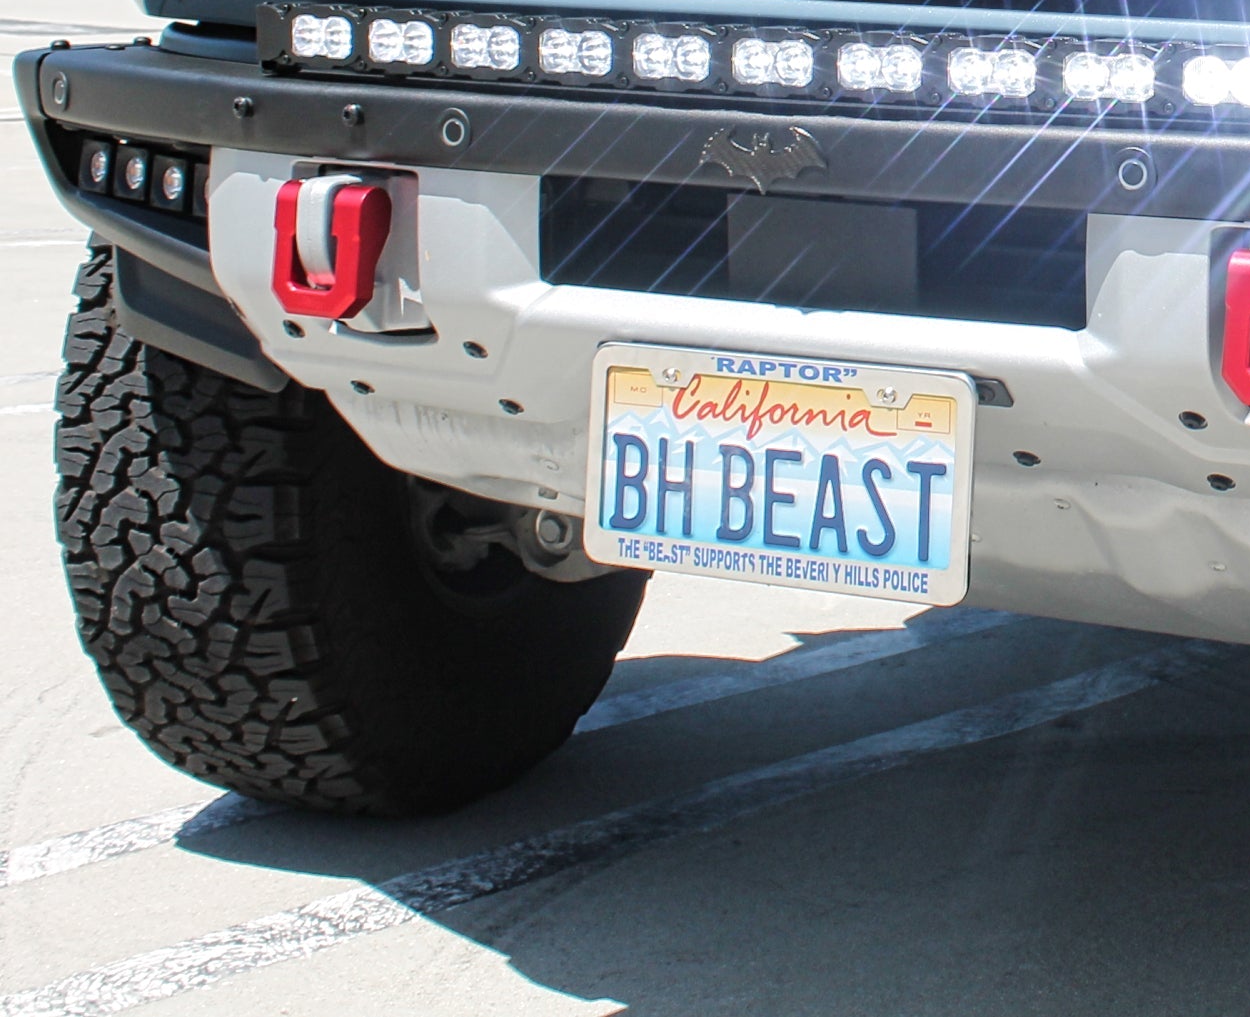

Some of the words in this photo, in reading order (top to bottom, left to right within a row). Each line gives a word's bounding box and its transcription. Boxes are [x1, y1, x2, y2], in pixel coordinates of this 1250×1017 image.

[671, 374, 898, 441] California
[609, 433, 695, 536] BH
[715, 443, 947, 562] BEAST
[618, 537, 641, 560] THE
[693, 546, 756, 573] SUPPORTS
[758, 554, 783, 577] THE
[844, 564, 880, 589] HILLS
[883, 568, 929, 594] POLICE
